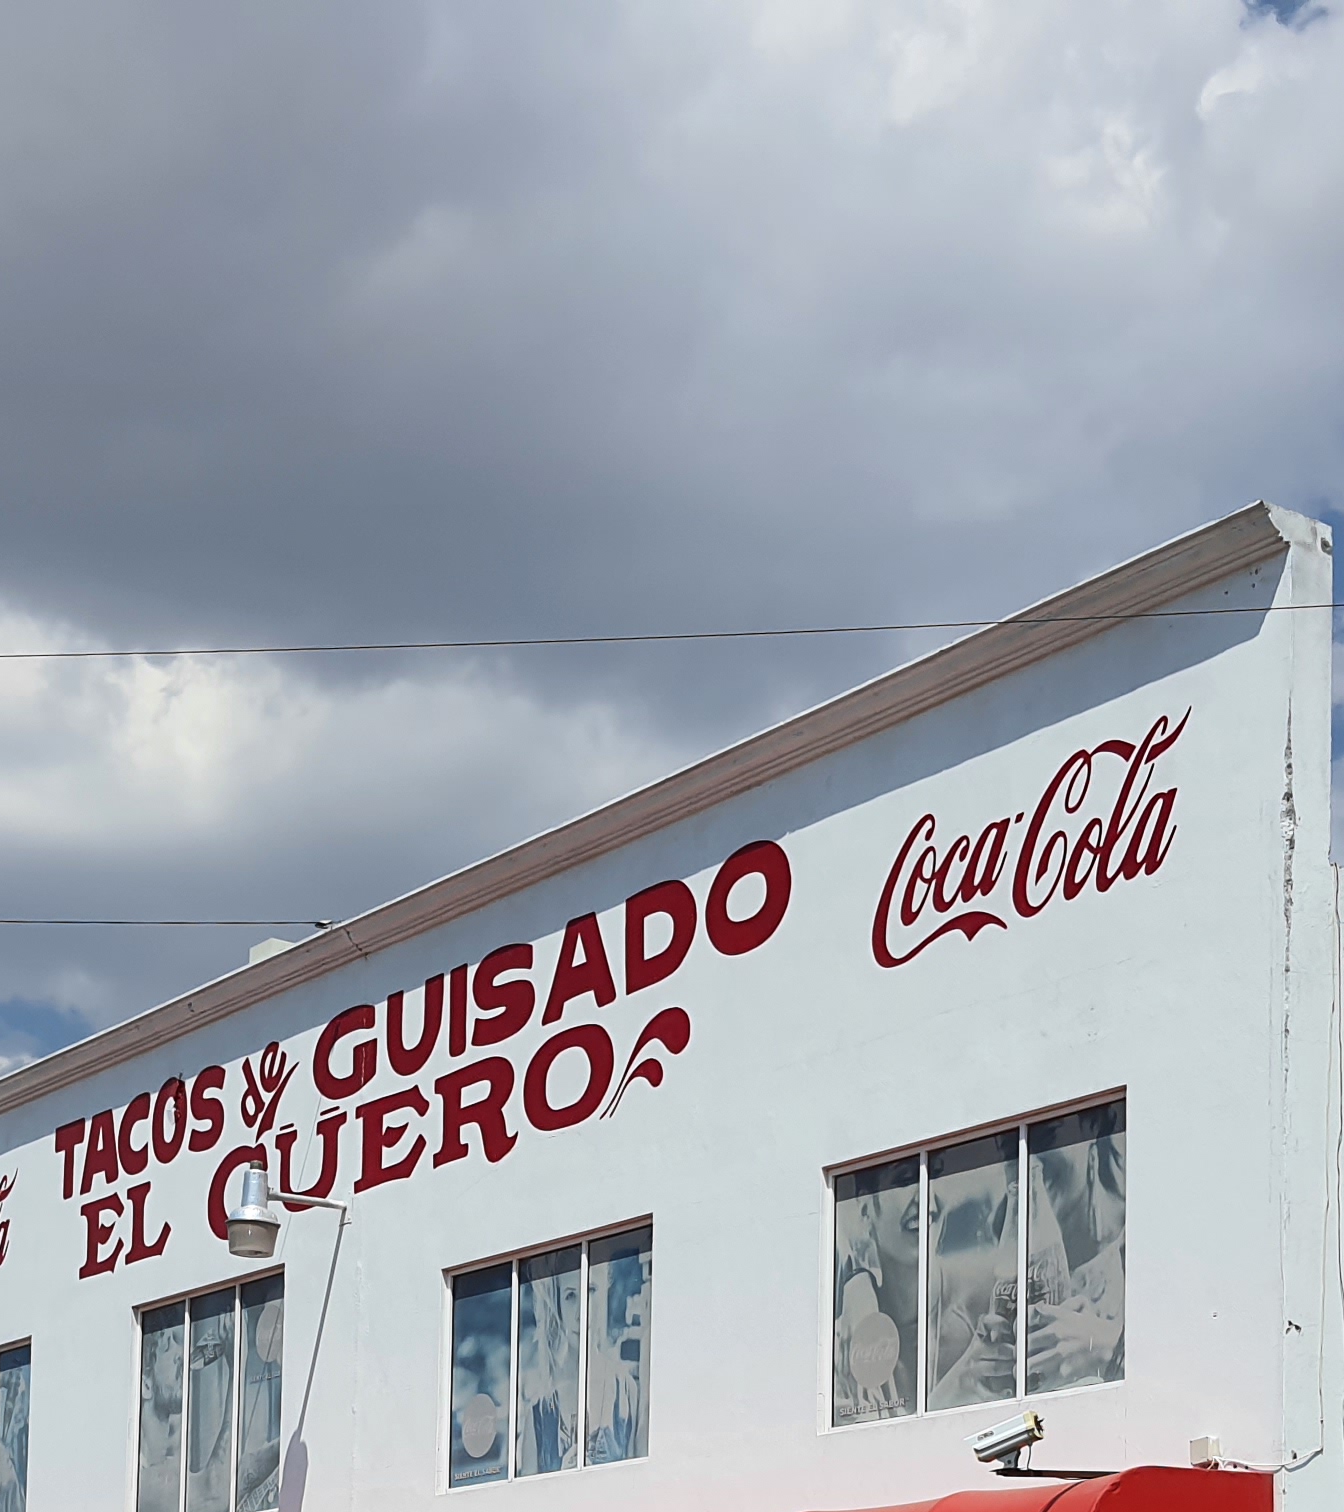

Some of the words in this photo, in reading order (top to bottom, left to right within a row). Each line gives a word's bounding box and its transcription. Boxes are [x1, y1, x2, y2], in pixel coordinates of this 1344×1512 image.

[55, 1064, 225, 1198] TACOS
[240, 1040, 299, 1144] de
[312, 841, 793, 1101] GUISADO
[78, 1182, 172, 1280] EL
[839, 1405, 866, 1416] SIENTE
[869, 1403, 877, 1411] EL
[879, 1397, 906, 1409] SABOR
